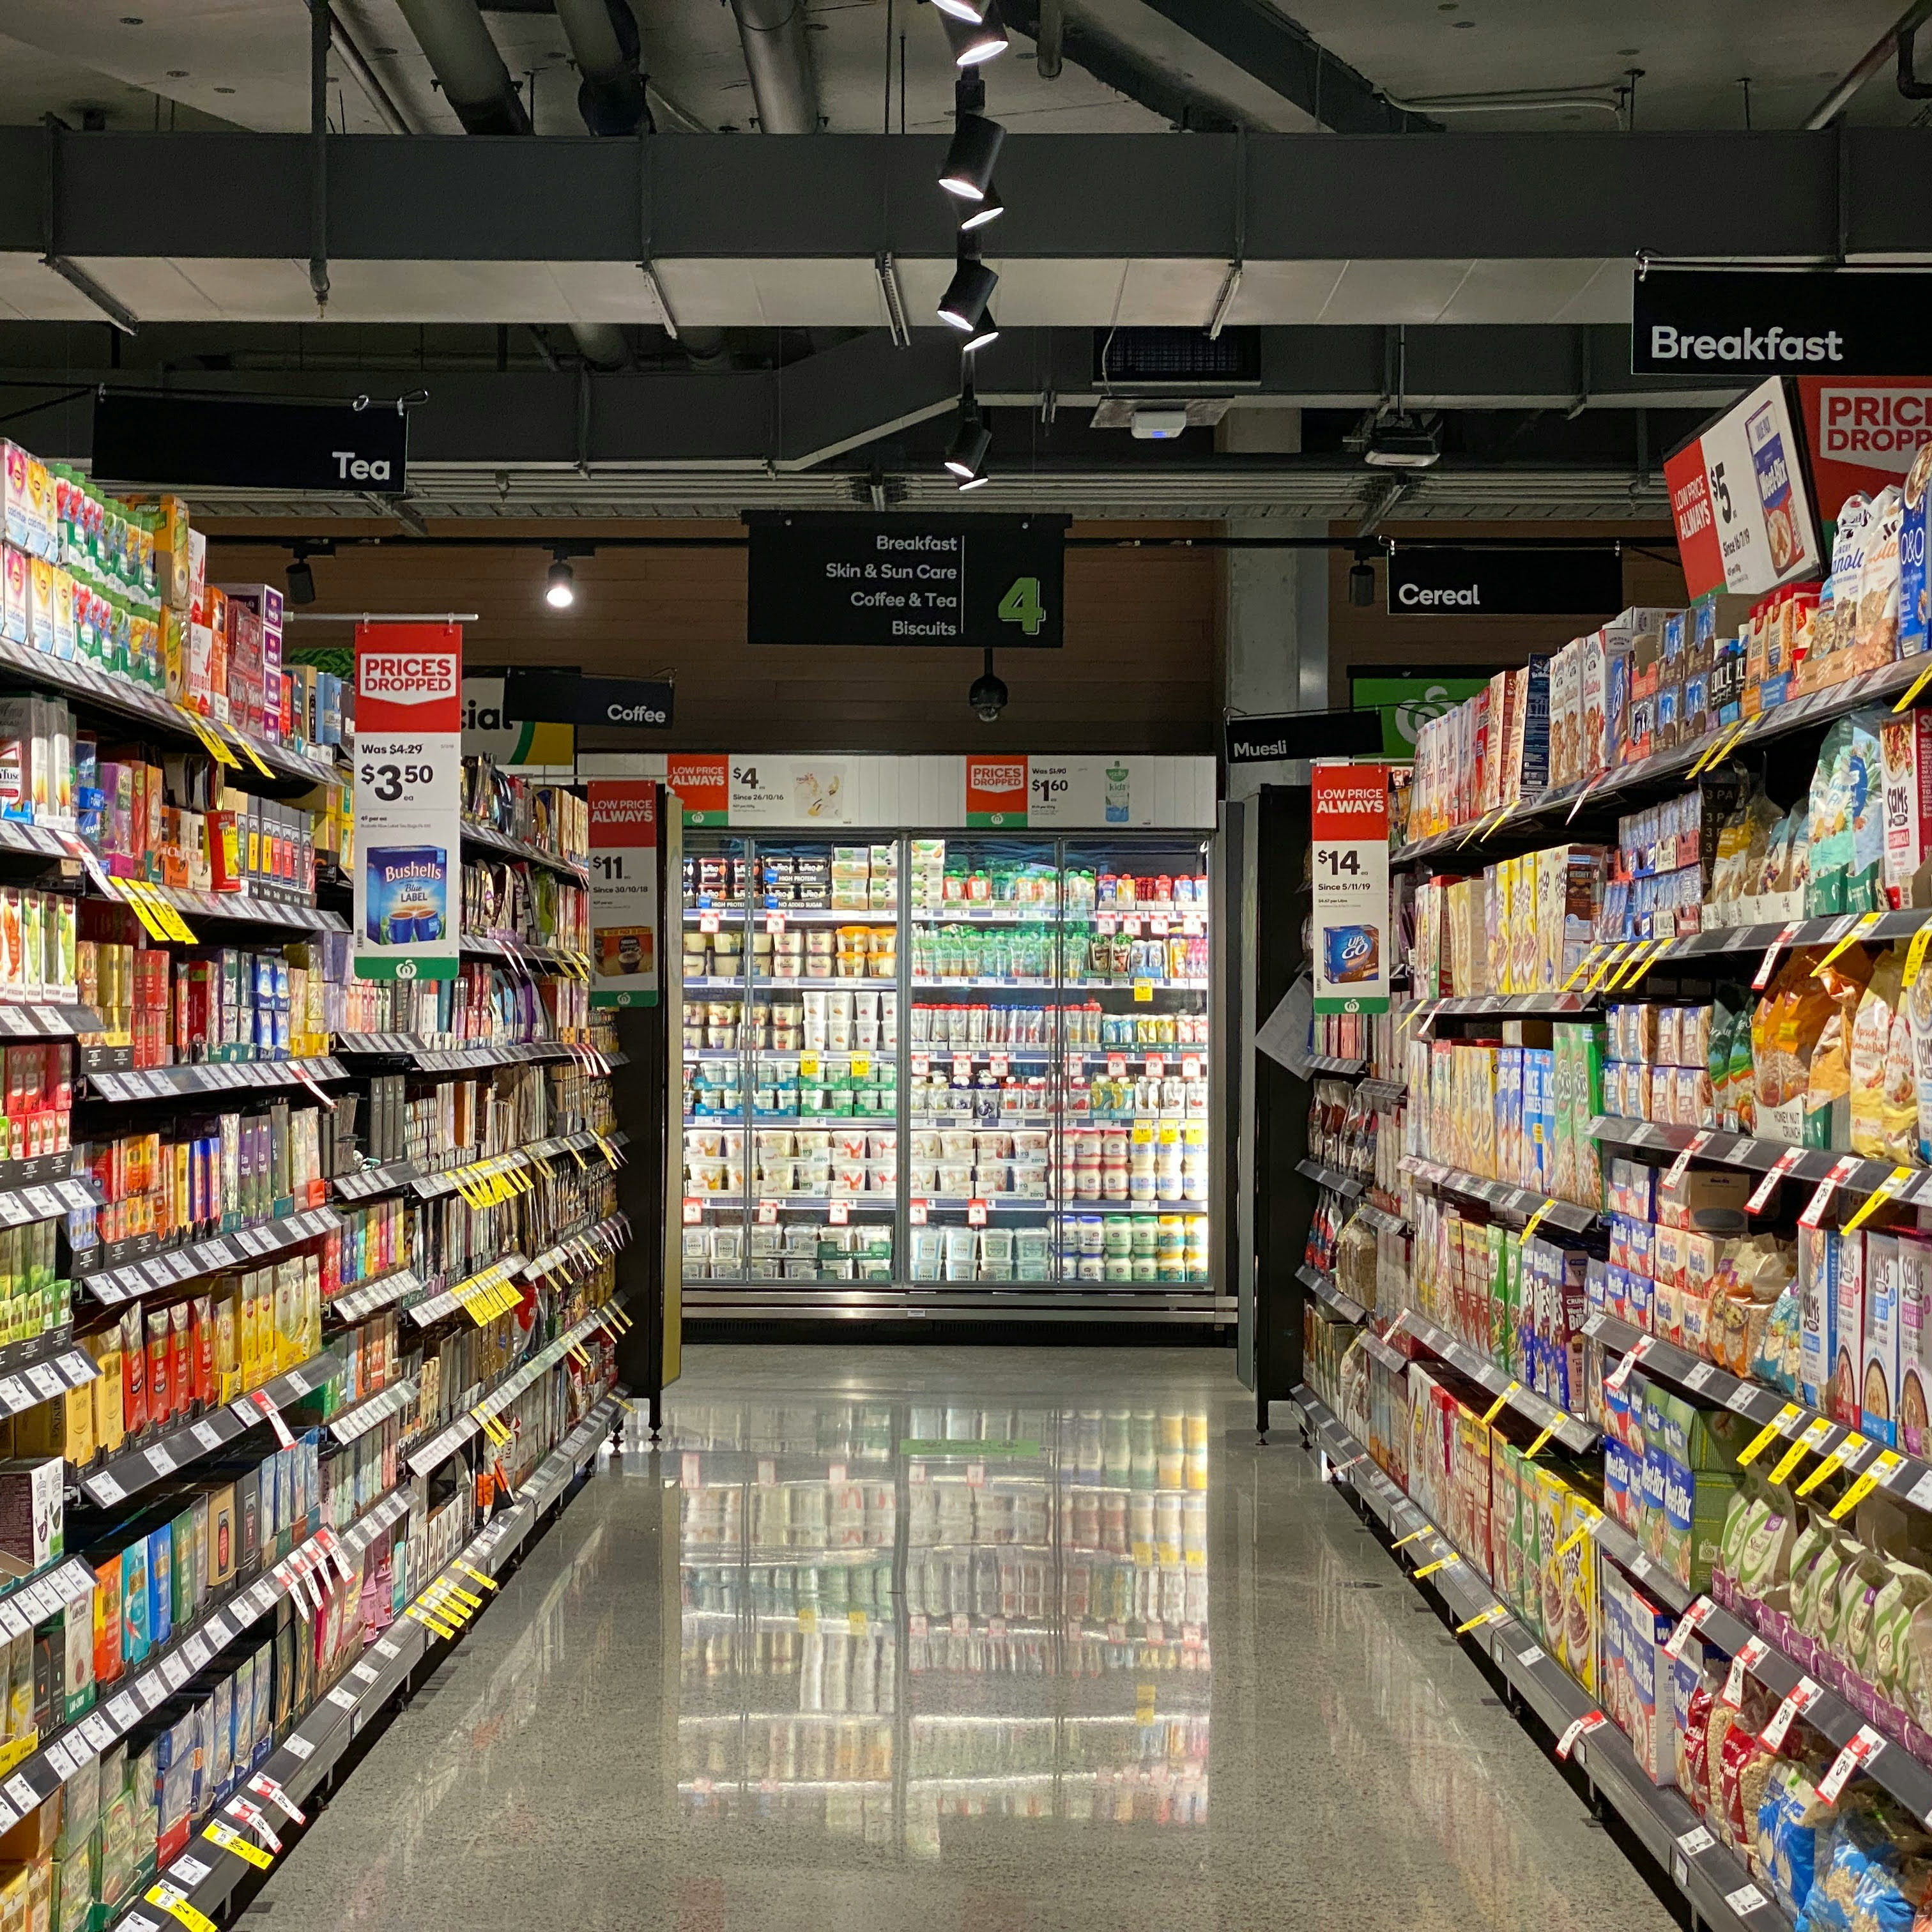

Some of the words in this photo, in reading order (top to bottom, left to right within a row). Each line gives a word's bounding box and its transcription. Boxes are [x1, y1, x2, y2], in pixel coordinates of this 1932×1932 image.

[1651, 326, 1843, 361] Breakfast
[1828, 396, 1932, 427] PRIC
[1828, 429, 1932, 451] DROPP
[332, 451, 390, 480] Tea
[1674, 487, 1690, 510] LOW
[1687, 474, 1706, 503] PRICE
[1678, 499, 1711, 541] ALWAYS
[877, 535, 957, 551] Breakfast
[826, 563, 861, 579] Skin
[865, 564, 877, 579] &
[881, 564, 913, 579] Sun
[917, 564, 957, 580] Care
[850, 591, 905, 607] Coffee
[909, 593, 921, 608] &
[925, 592, 957, 608] Tea
[1399, 583, 1480, 606] Cereal
[998, 577, 1046, 635] 4
[892, 620, 956, 636] Biscuits
[365, 658, 451, 677] PRICES
[365, 678, 451, 691] DROPPED
[607, 703, 666, 723] Coffee
[362, 744, 387, 755] Was
[390, 743, 424, 755] $4.29
[1234, 739, 1287, 758] Muesli
[673, 766, 694, 775] LOW
[696, 766, 724, 775] PRICE
[733, 767, 759, 790] $4
[973, 767, 1021, 779] PRICES
[672, 775, 724, 786] ALWAYS
[1109, 782, 1126, 792] kids
[1317, 789, 1344, 799] LOW
[1348, 788, 1383, 799] PRICE
[592, 801, 617, 811] LOW
[620, 800, 652, 810] PRICE
[1317, 799, 1384, 813] ALWAYS
[592, 810, 654, 823] ALWAYS
[593, 855, 623, 880] $11
[1318, 849, 1361, 876] $14
[385, 861, 442, 883] Bushells
[405, 884, 422, 893] Blue
[615, 885, 648, 894] 30/10/18
[1342, 883, 1370, 891] 5/11/19
[401, 893, 427, 903] LABEL
[1342, 942, 1368, 960] GO
